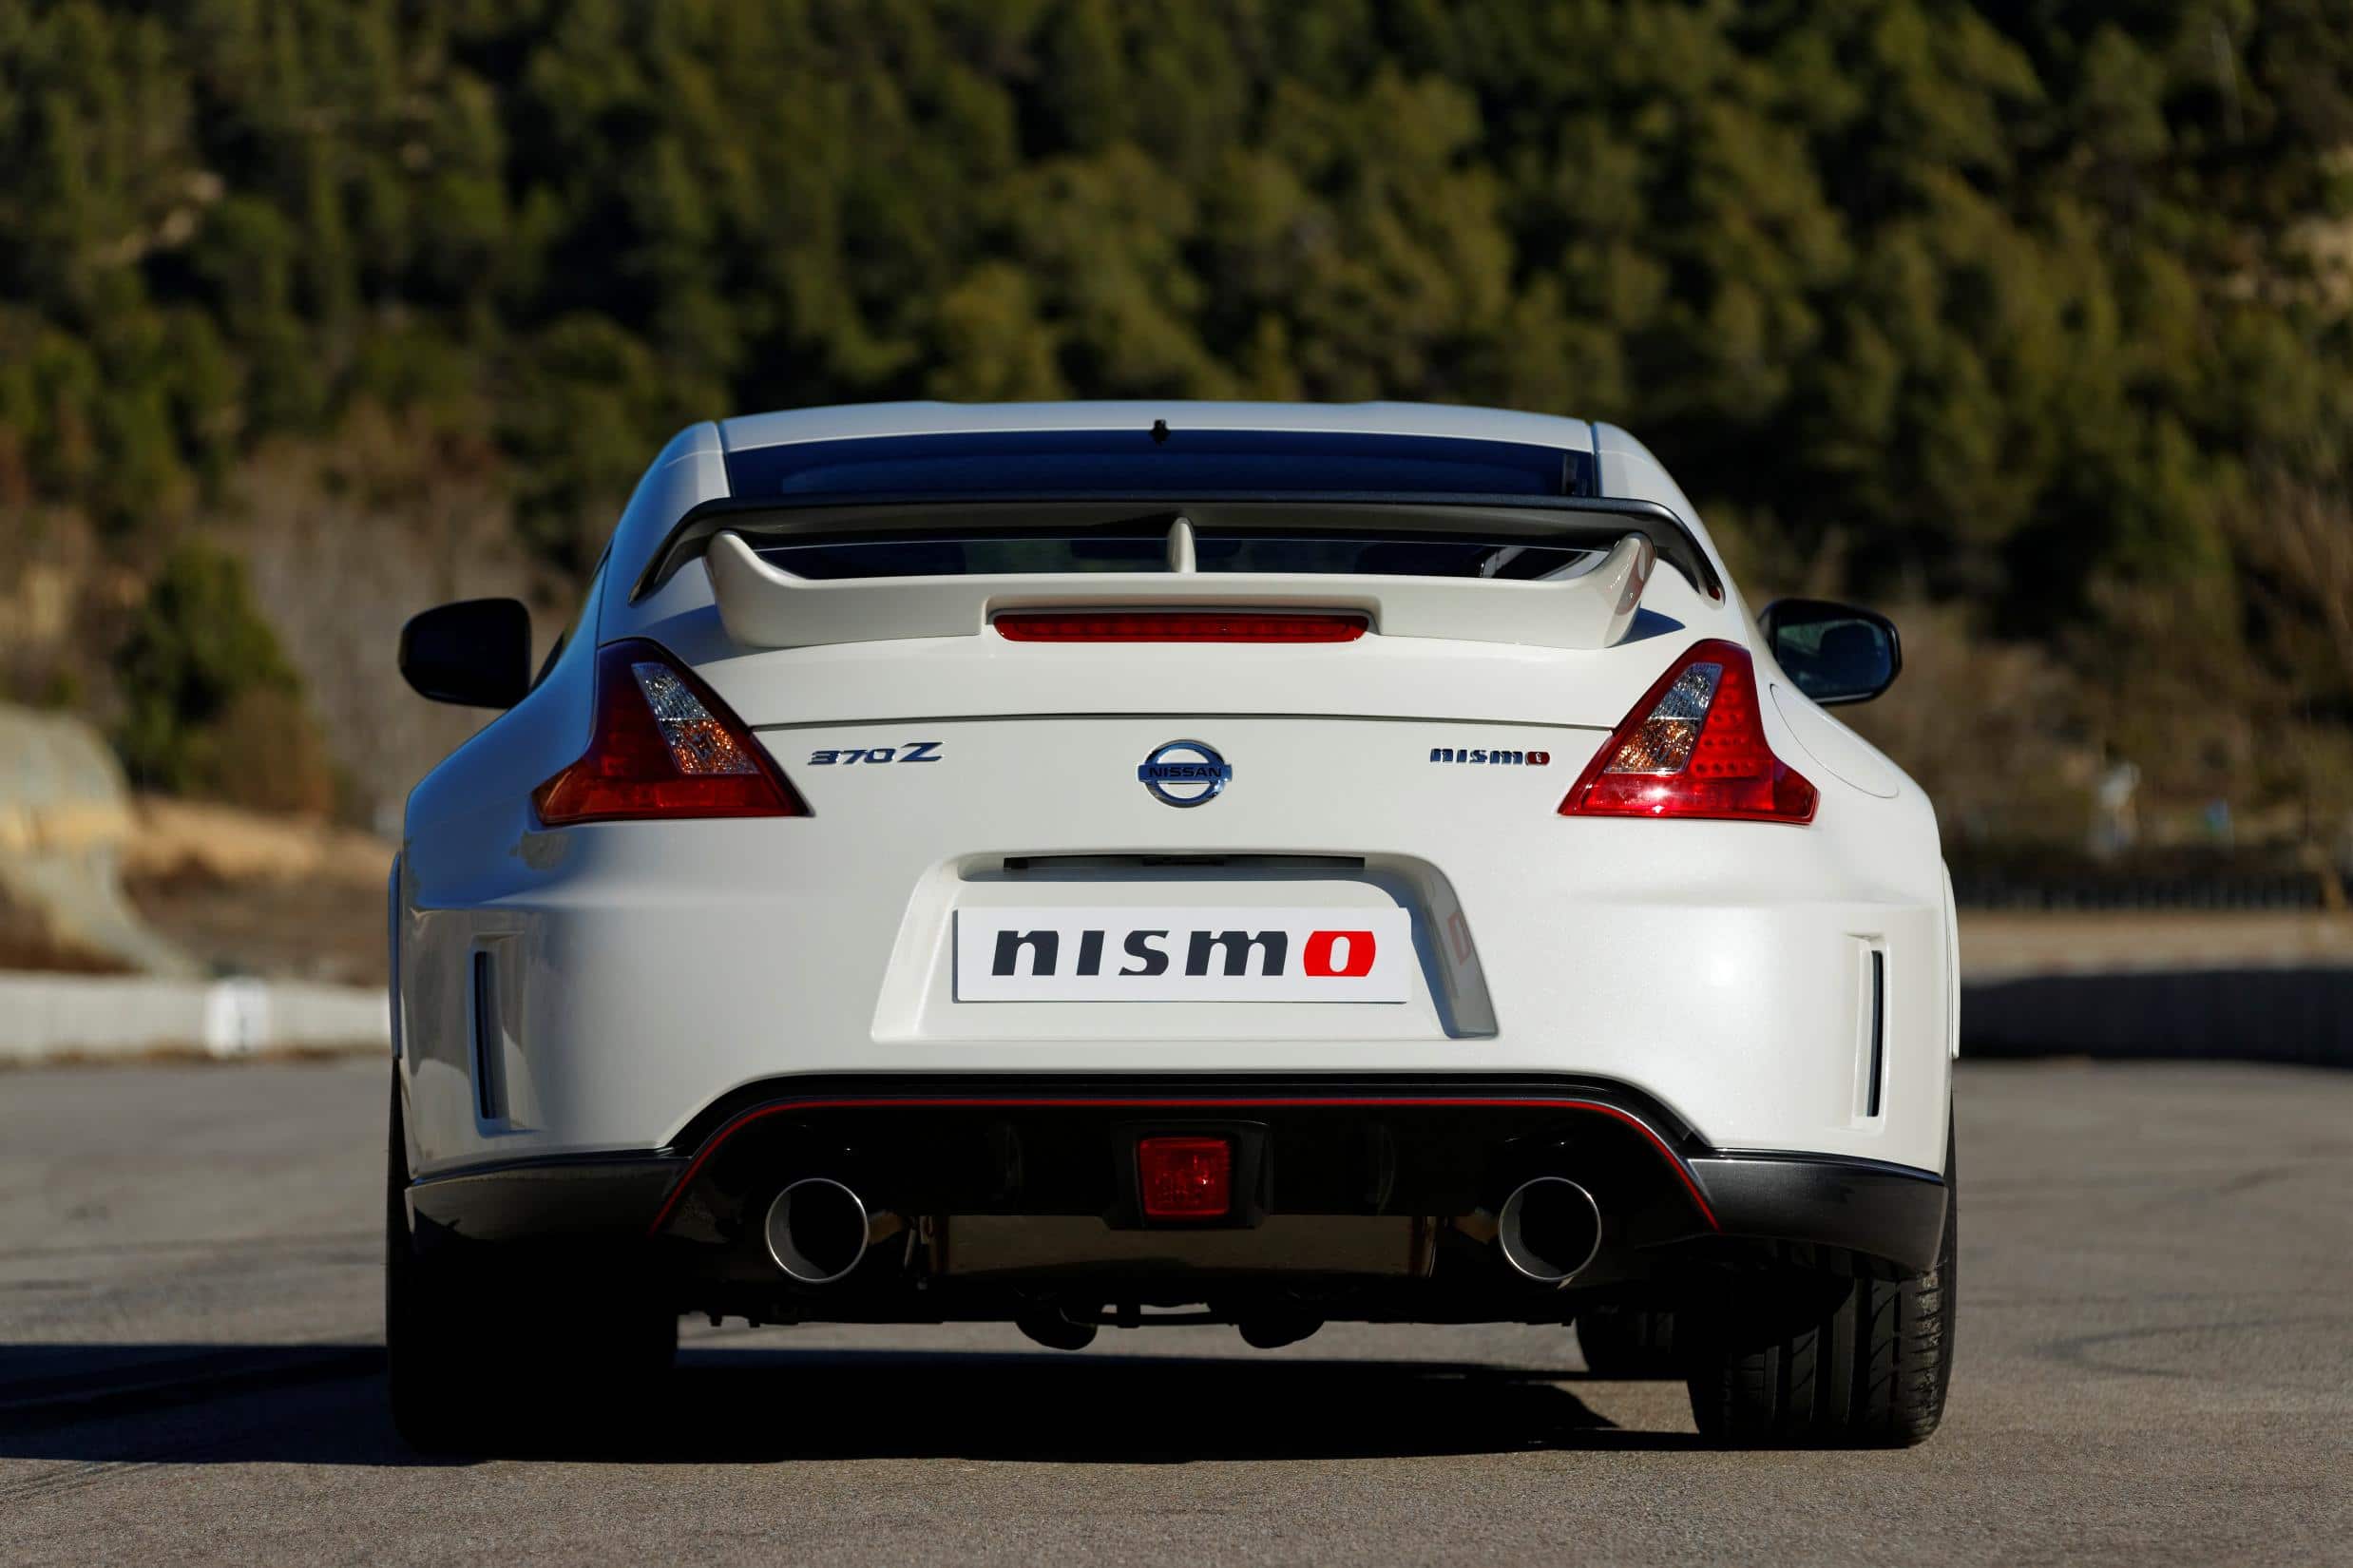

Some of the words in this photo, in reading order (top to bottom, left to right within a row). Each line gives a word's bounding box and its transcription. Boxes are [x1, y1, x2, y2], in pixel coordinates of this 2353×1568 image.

[808, 742, 944, 765] 370Z
[1430, 749, 1550, 766] nismo
[1149, 767, 1222, 777] NISSAN
[991, 929, 1376, 977] nismo
